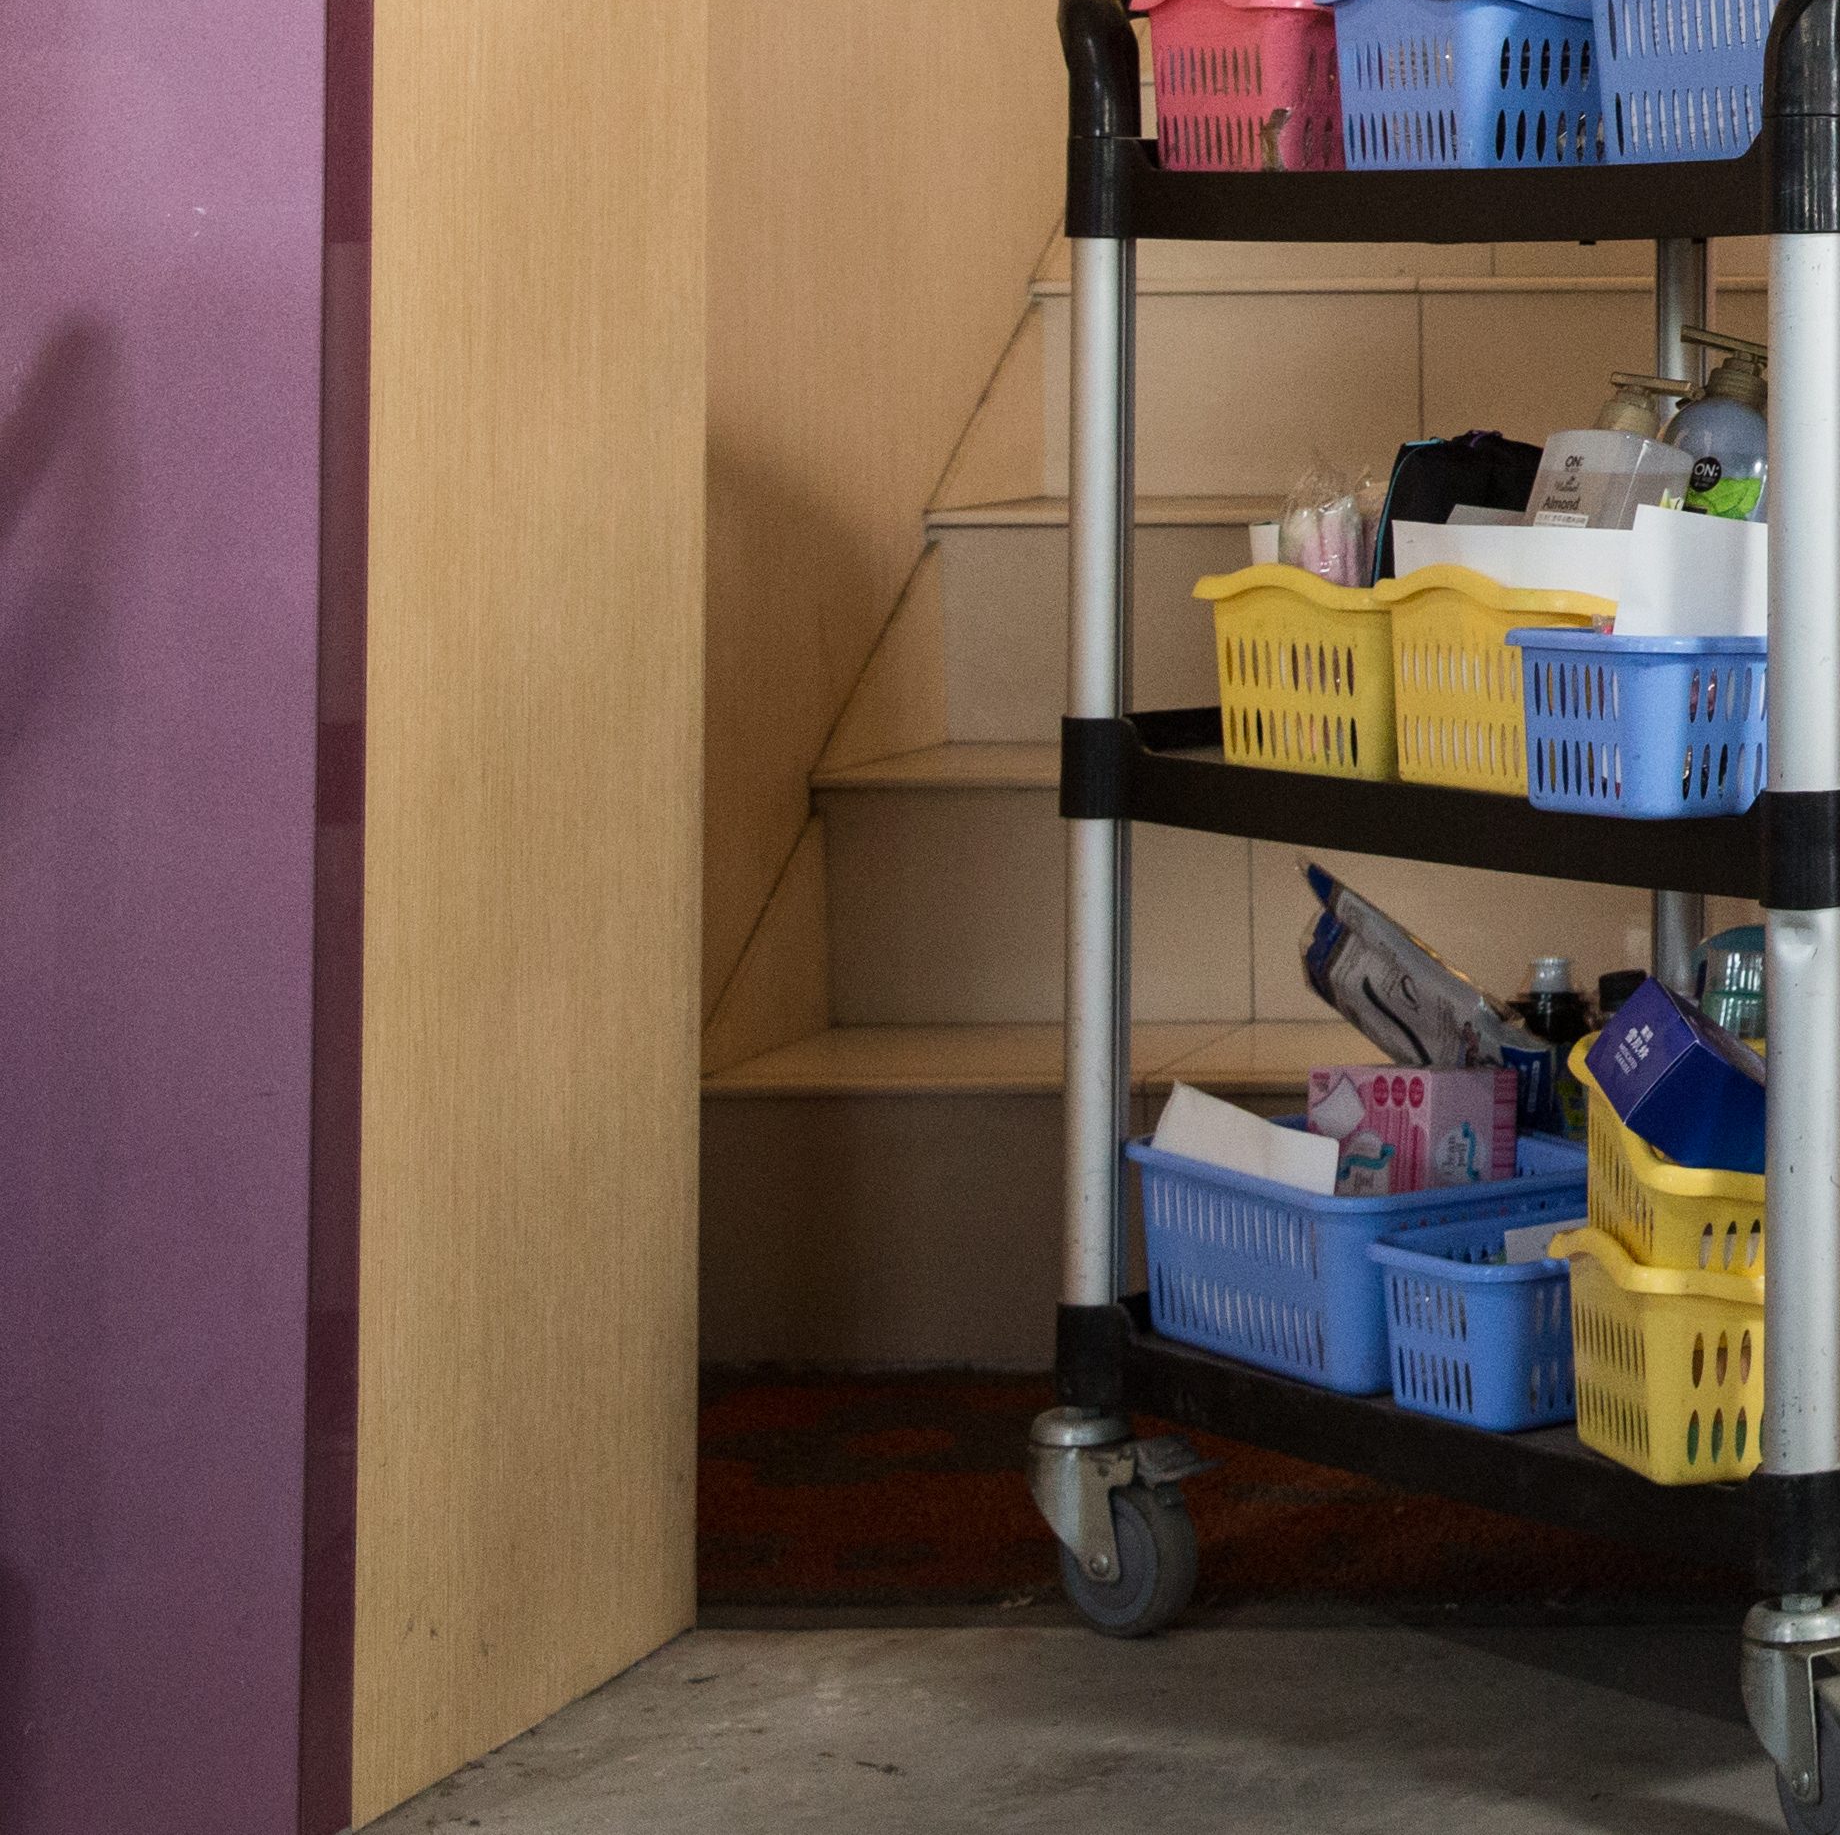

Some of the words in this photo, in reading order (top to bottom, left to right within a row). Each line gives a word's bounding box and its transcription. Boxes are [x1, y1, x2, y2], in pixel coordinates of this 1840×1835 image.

[1565, 455, 1586, 468] ON:
[1694, 463, 1720, 477] ON:
[1542, 496, 1581, 511] Almond
